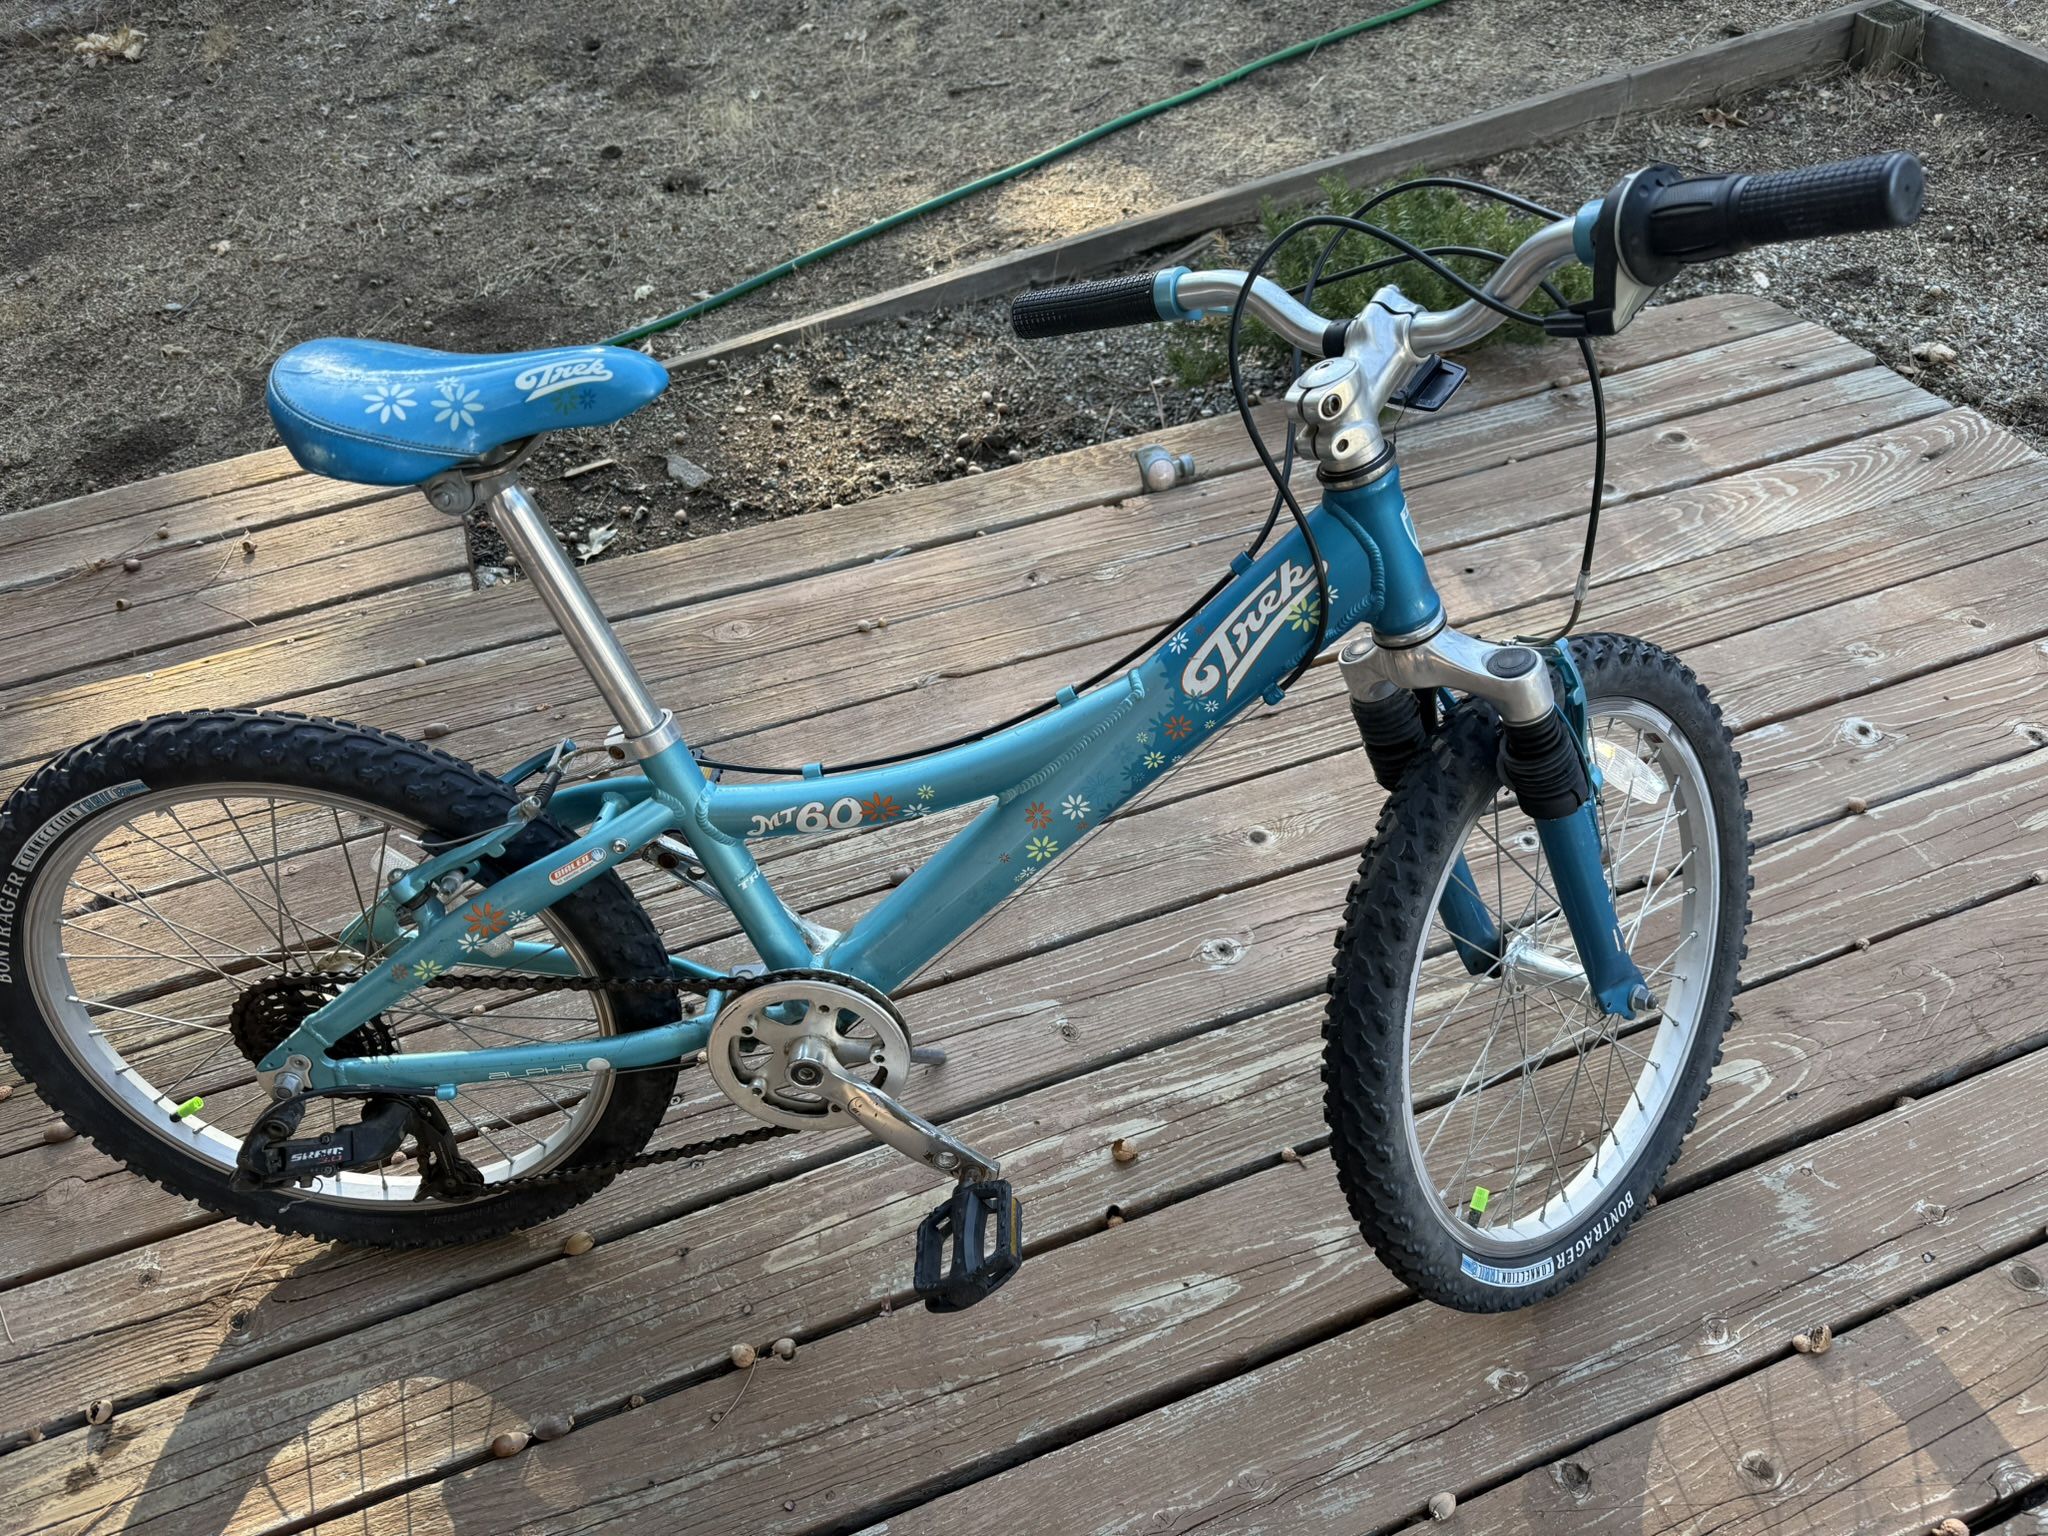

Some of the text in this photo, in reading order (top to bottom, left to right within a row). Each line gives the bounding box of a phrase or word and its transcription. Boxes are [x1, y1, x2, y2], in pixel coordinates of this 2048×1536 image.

[515, 358, 614, 403] Trek
[1181, 559, 1329, 701] Trek
[18, 809, 78, 869] CONNECTION
[1556, 1190, 1635, 1270] BONTRAGER
[1501, 1263, 1553, 1286] CONNECTION
